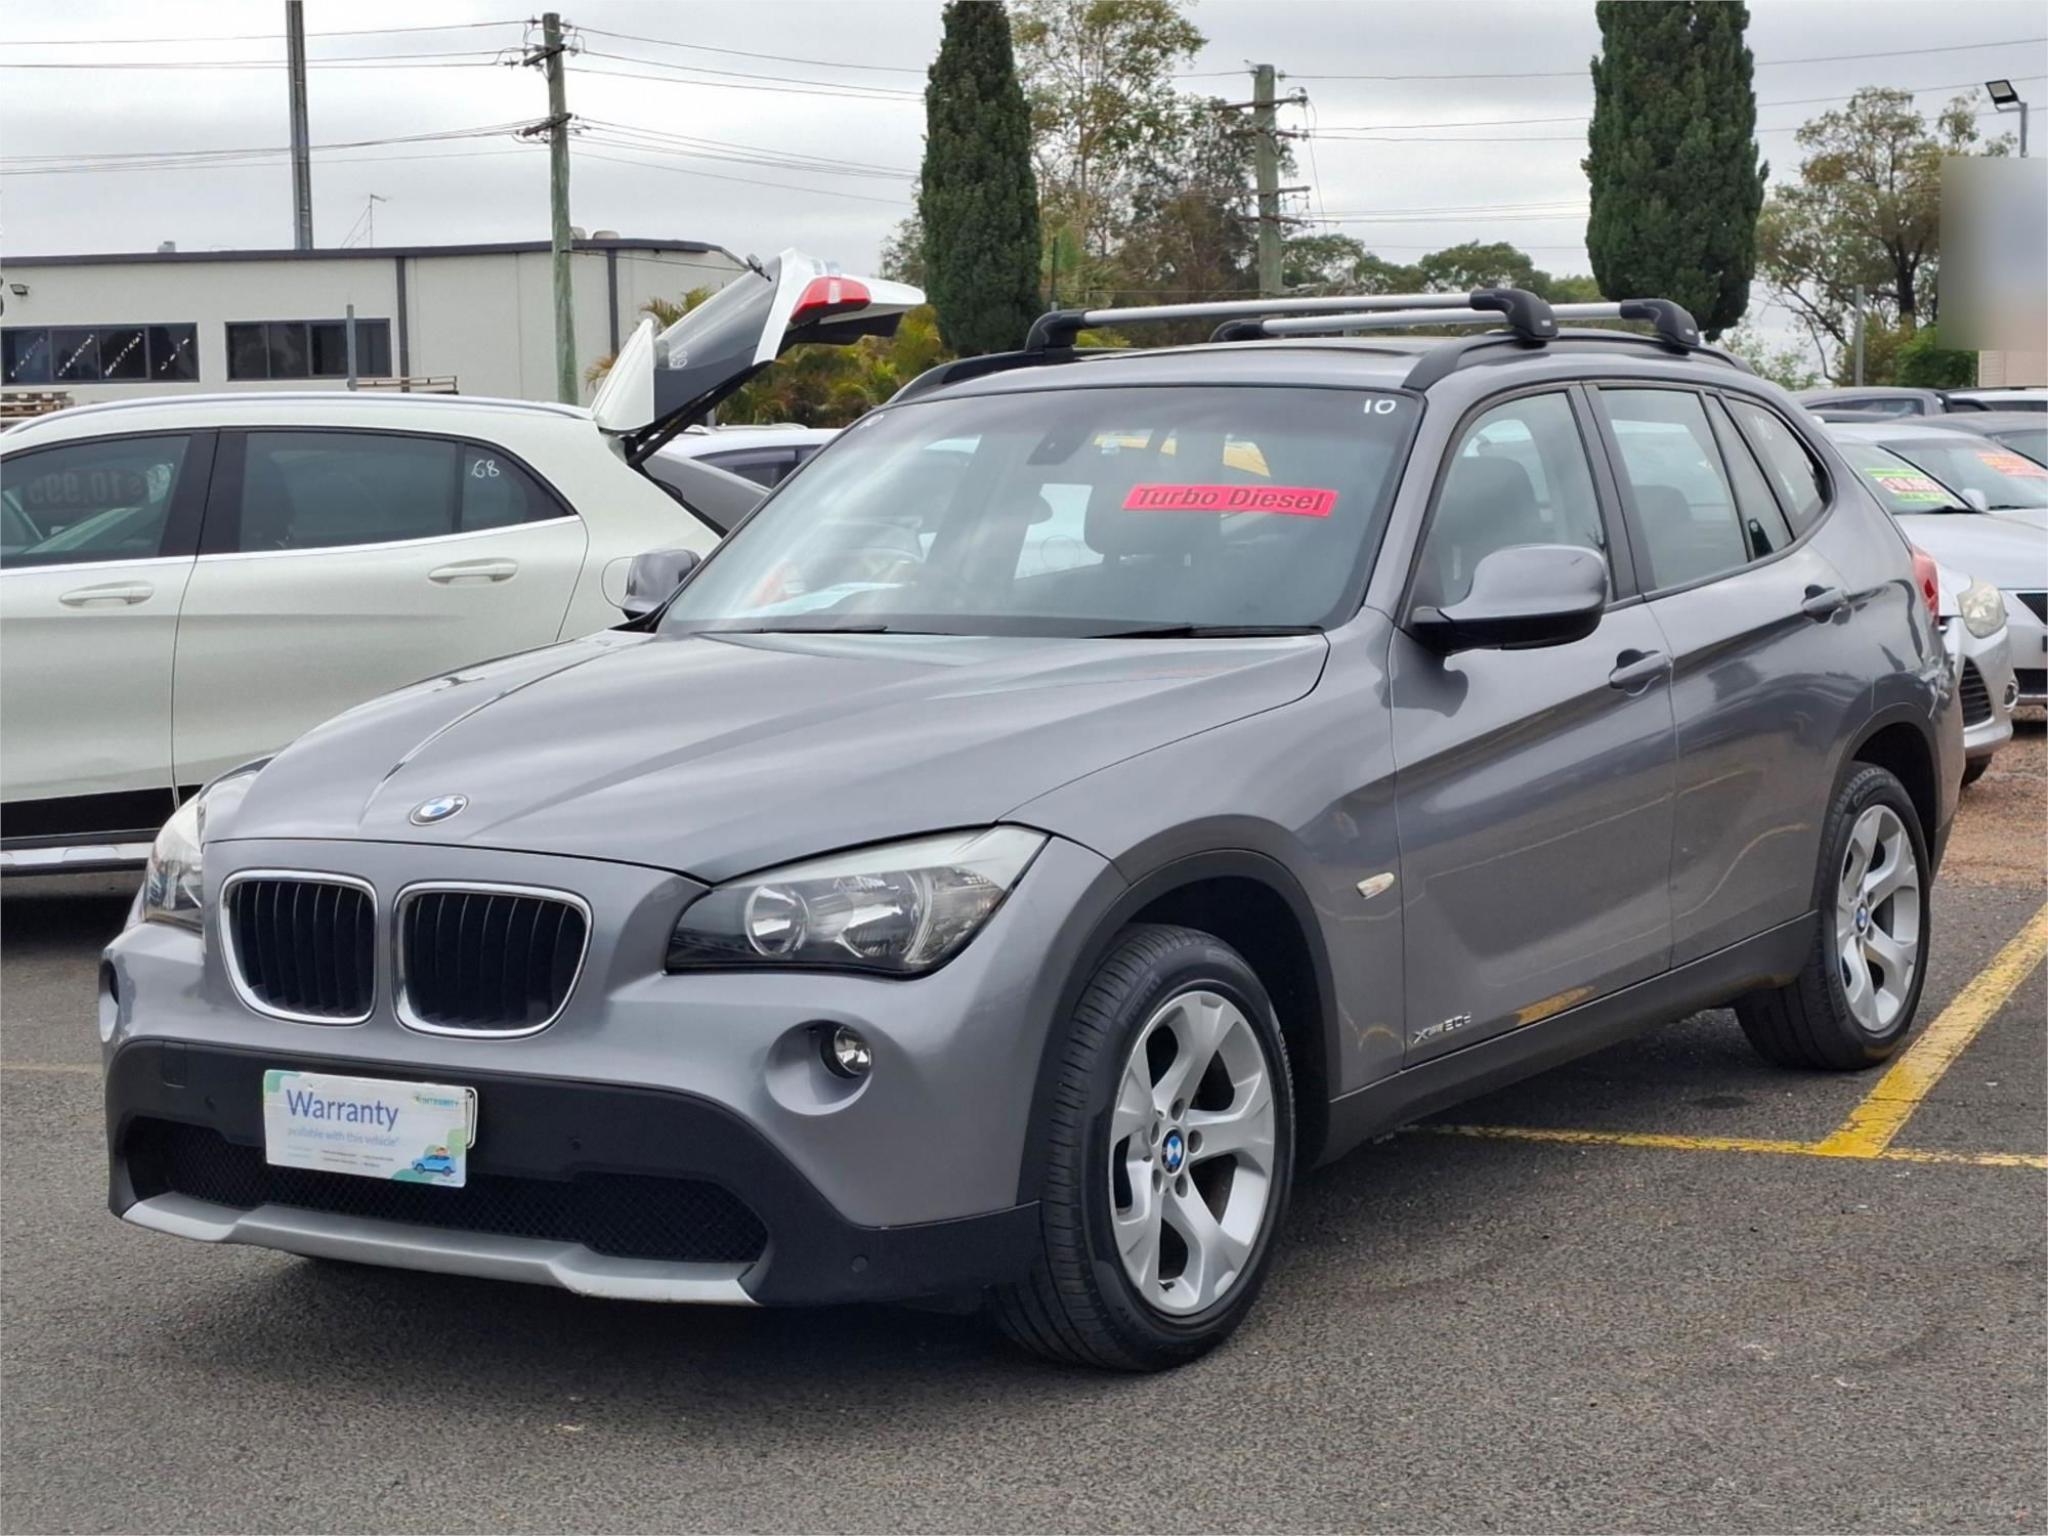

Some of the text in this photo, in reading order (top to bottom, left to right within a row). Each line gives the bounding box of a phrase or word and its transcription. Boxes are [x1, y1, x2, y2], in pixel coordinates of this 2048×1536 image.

[1364, 399, 1396, 414] 10
[471, 459, 500, 478] 68
[1137, 488, 1325, 511] Turbo Diesel
[286, 1089, 399, 1131] Warranty
